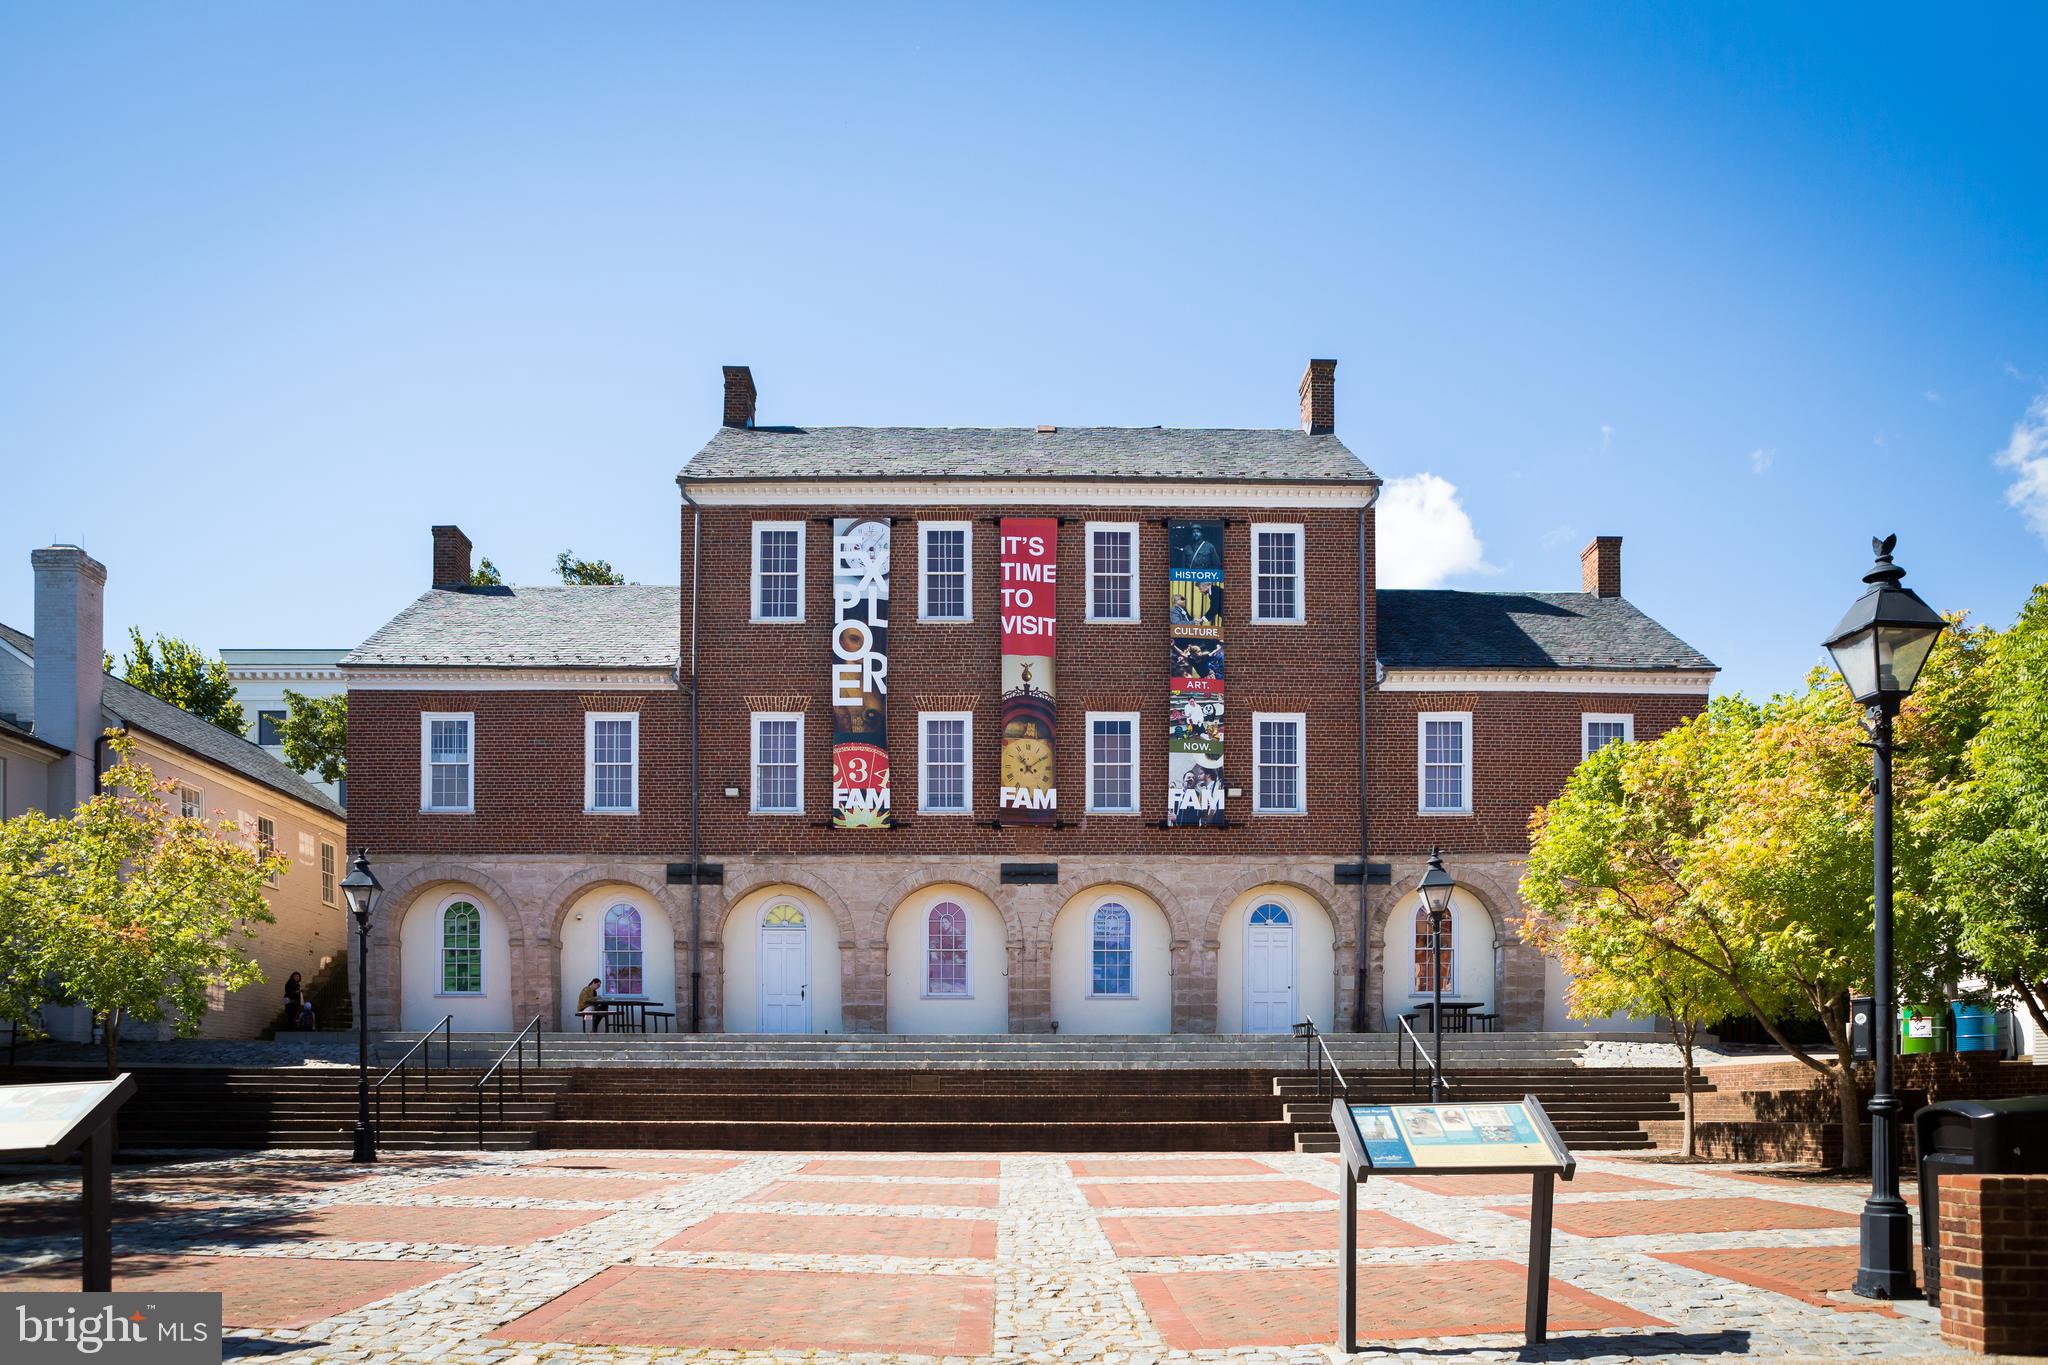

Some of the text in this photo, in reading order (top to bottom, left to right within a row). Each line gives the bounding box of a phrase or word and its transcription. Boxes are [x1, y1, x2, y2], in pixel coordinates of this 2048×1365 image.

[1001, 537, 1045, 556] IT'S
[1001, 563, 1056, 583] TIME
[1175, 571, 1219, 580] HISTORY.
[1001, 588, 1033, 608] TO
[1001, 616, 1056, 636] VISIT
[1174, 627, 1220, 638] CULTURE.
[1186, 681, 1210, 689] ART.
[1183, 742, 1211, 752] NOW.
[849, 757, 868, 783] 3
[832, 788, 890, 810] FAM
[1000, 786, 1056, 809] FAM
[1168, 788, 1225, 810] FAM
